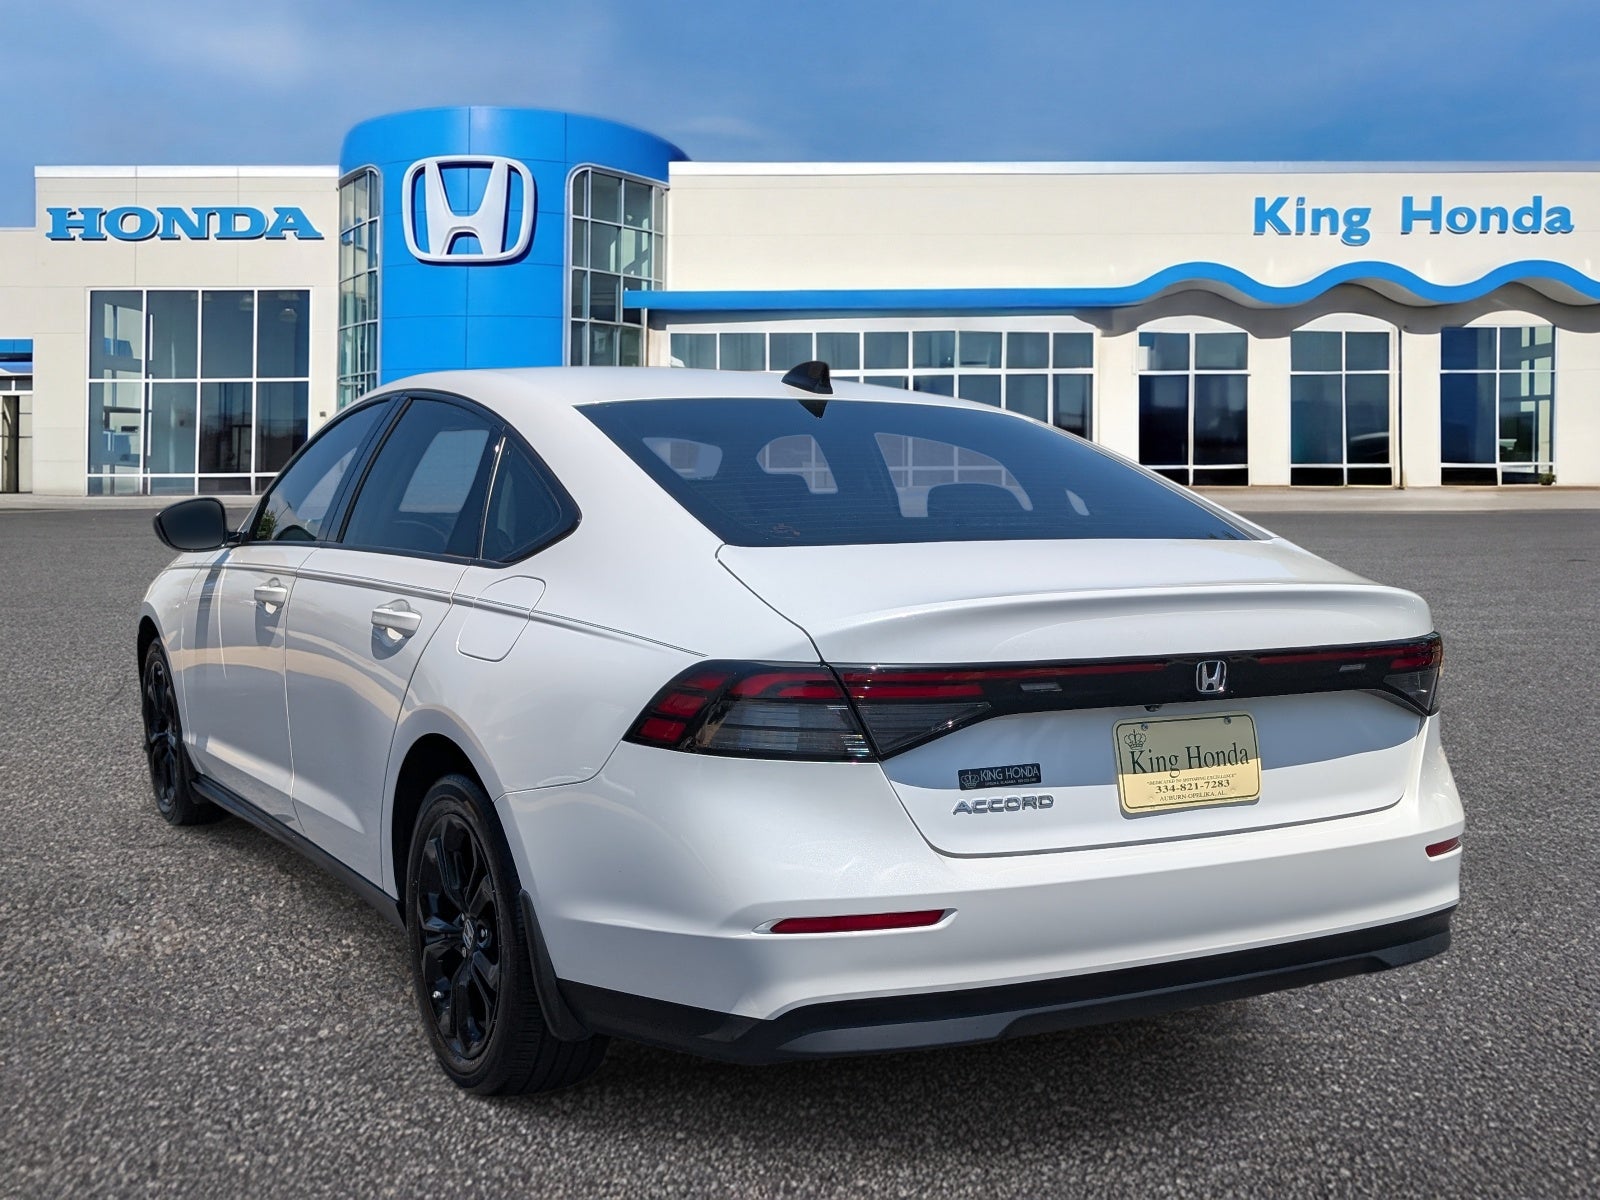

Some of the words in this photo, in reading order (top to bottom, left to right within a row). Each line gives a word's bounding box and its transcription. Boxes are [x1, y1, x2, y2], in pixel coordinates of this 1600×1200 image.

[46, 206, 324, 241] HONDA
[1253, 196, 1372, 247] King
[1400, 195, 1575, 235] Honda
[980, 768, 1003, 781] KING
[1006, 765, 1040, 780] HONDA
[1129, 748, 1180, 778] King
[1185, 741, 1250, 770] Honda
[1155, 779, 1230, 794] 334-821-7283
[952, 795, 1054, 815] ACCORD
